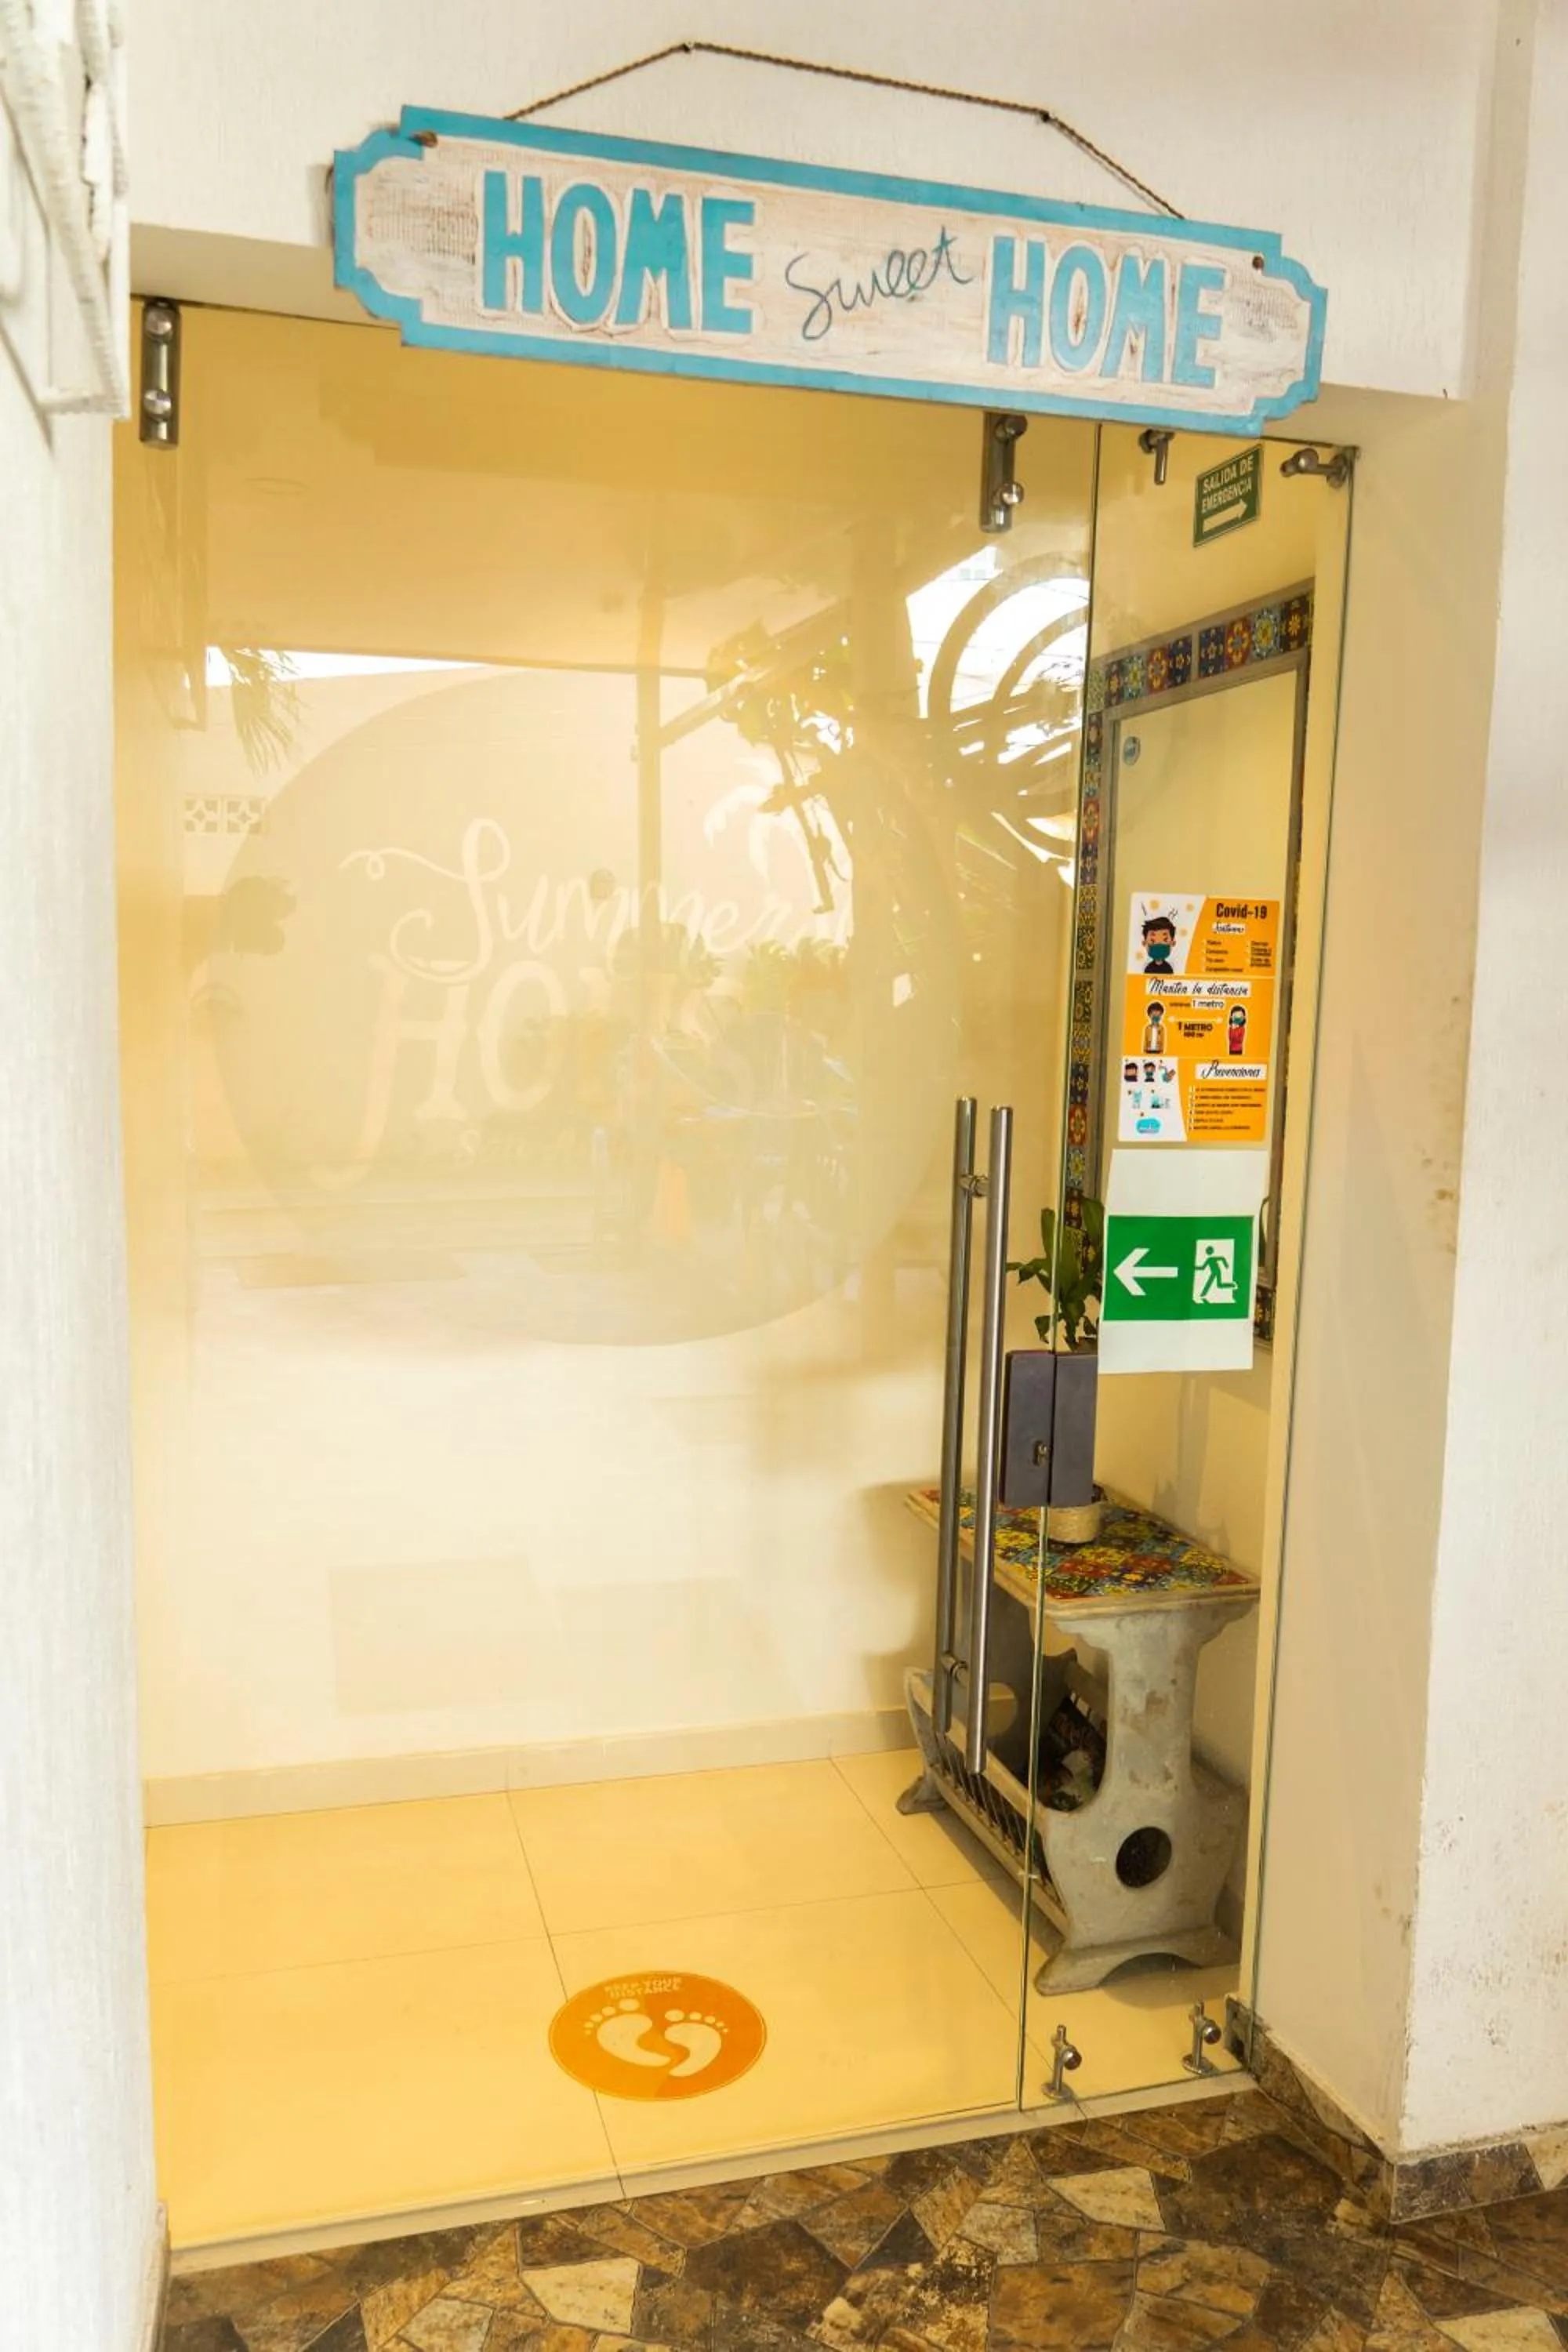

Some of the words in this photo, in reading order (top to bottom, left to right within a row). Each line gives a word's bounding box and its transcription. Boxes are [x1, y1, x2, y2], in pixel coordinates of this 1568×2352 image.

[482, 170, 755, 335] HOME
[784, 225, 977, 341] Sweet
[986, 236, 1227, 389] HOME
[1203, 463, 1237, 494] SALIDA
[1240, 455, 1254, 476] DE
[1201, 476, 1252, 514] EMERGENCIA
[1216, 902, 1268, 920] Covid-19
[1184, 1023, 1213, 1033] METRO
